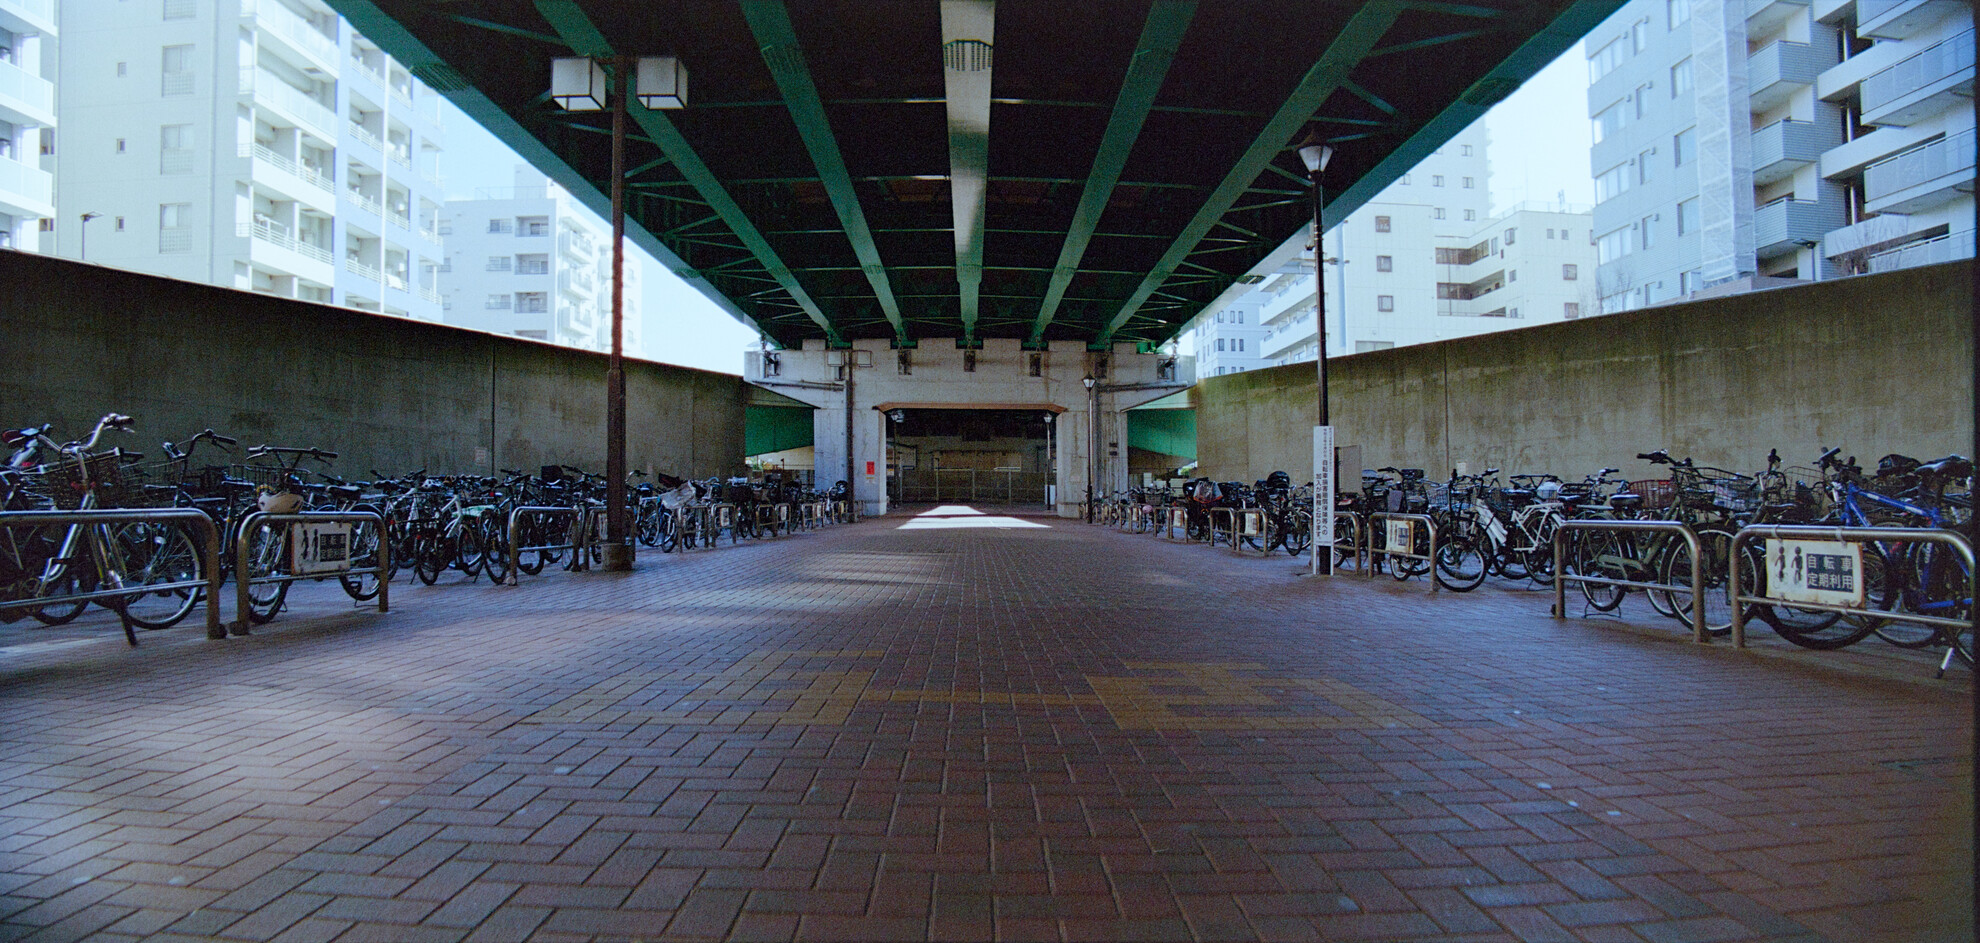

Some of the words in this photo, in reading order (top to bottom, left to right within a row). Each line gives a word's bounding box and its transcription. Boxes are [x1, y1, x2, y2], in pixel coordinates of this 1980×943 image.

[1808, 555, 1851, 571] 自転車
[1808, 572, 1853, 589] 定期利用
